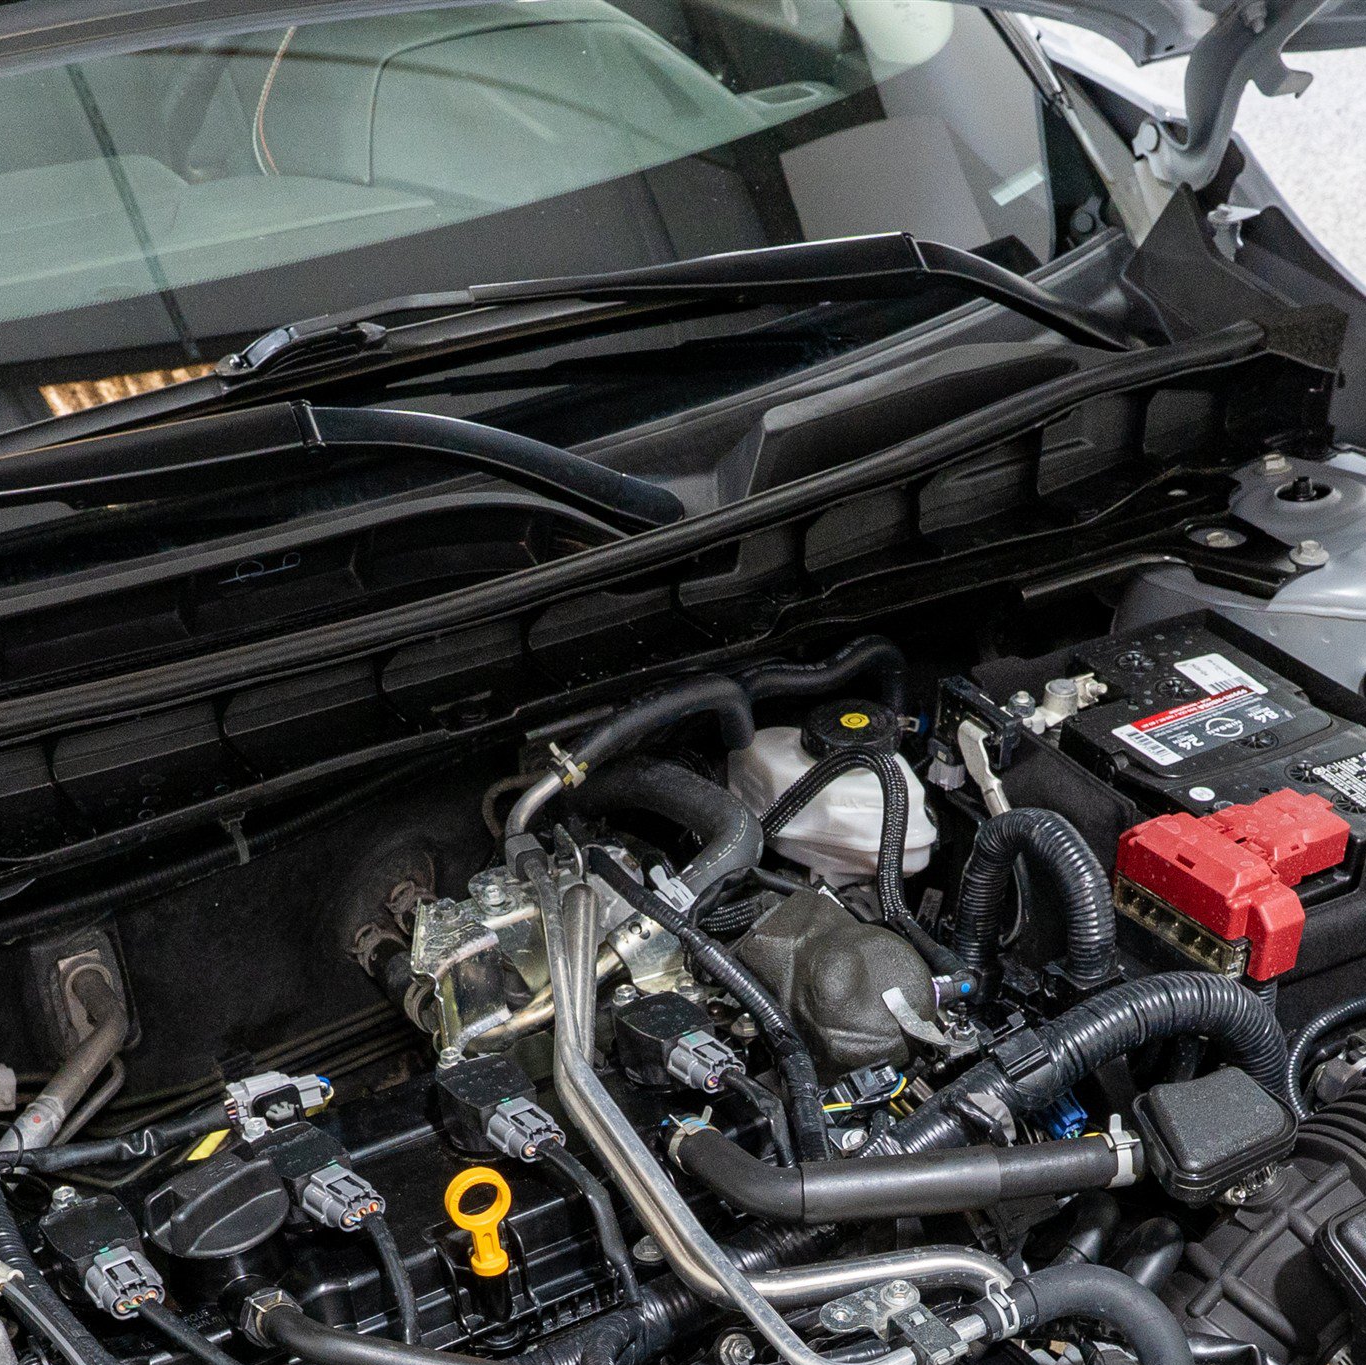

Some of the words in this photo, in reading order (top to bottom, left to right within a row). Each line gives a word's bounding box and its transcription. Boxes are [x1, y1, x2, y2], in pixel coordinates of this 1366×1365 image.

[1251, 709, 1281, 724] 84
[1204, 719, 1243, 735] NISSAN
[1175, 736, 1206, 751] 24
